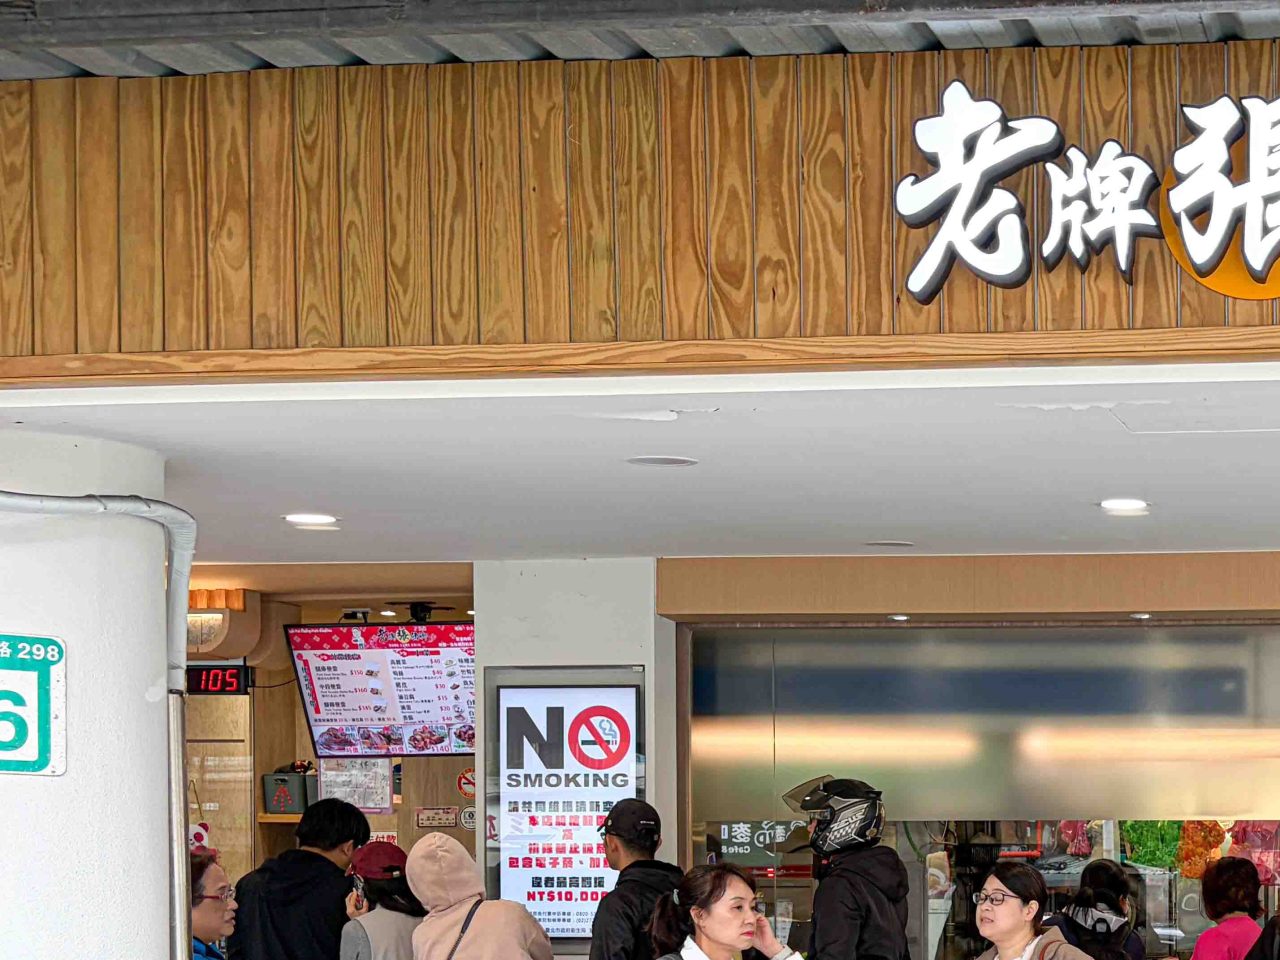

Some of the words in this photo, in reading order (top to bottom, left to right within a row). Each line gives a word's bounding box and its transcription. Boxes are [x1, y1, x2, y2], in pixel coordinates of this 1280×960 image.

[17, 642, 60, 662] 298
[200, 669, 238, 691] 105
[506, 773, 629, 788] SMOKING
[508, 801, 616, 813] 請共同維護清新空
